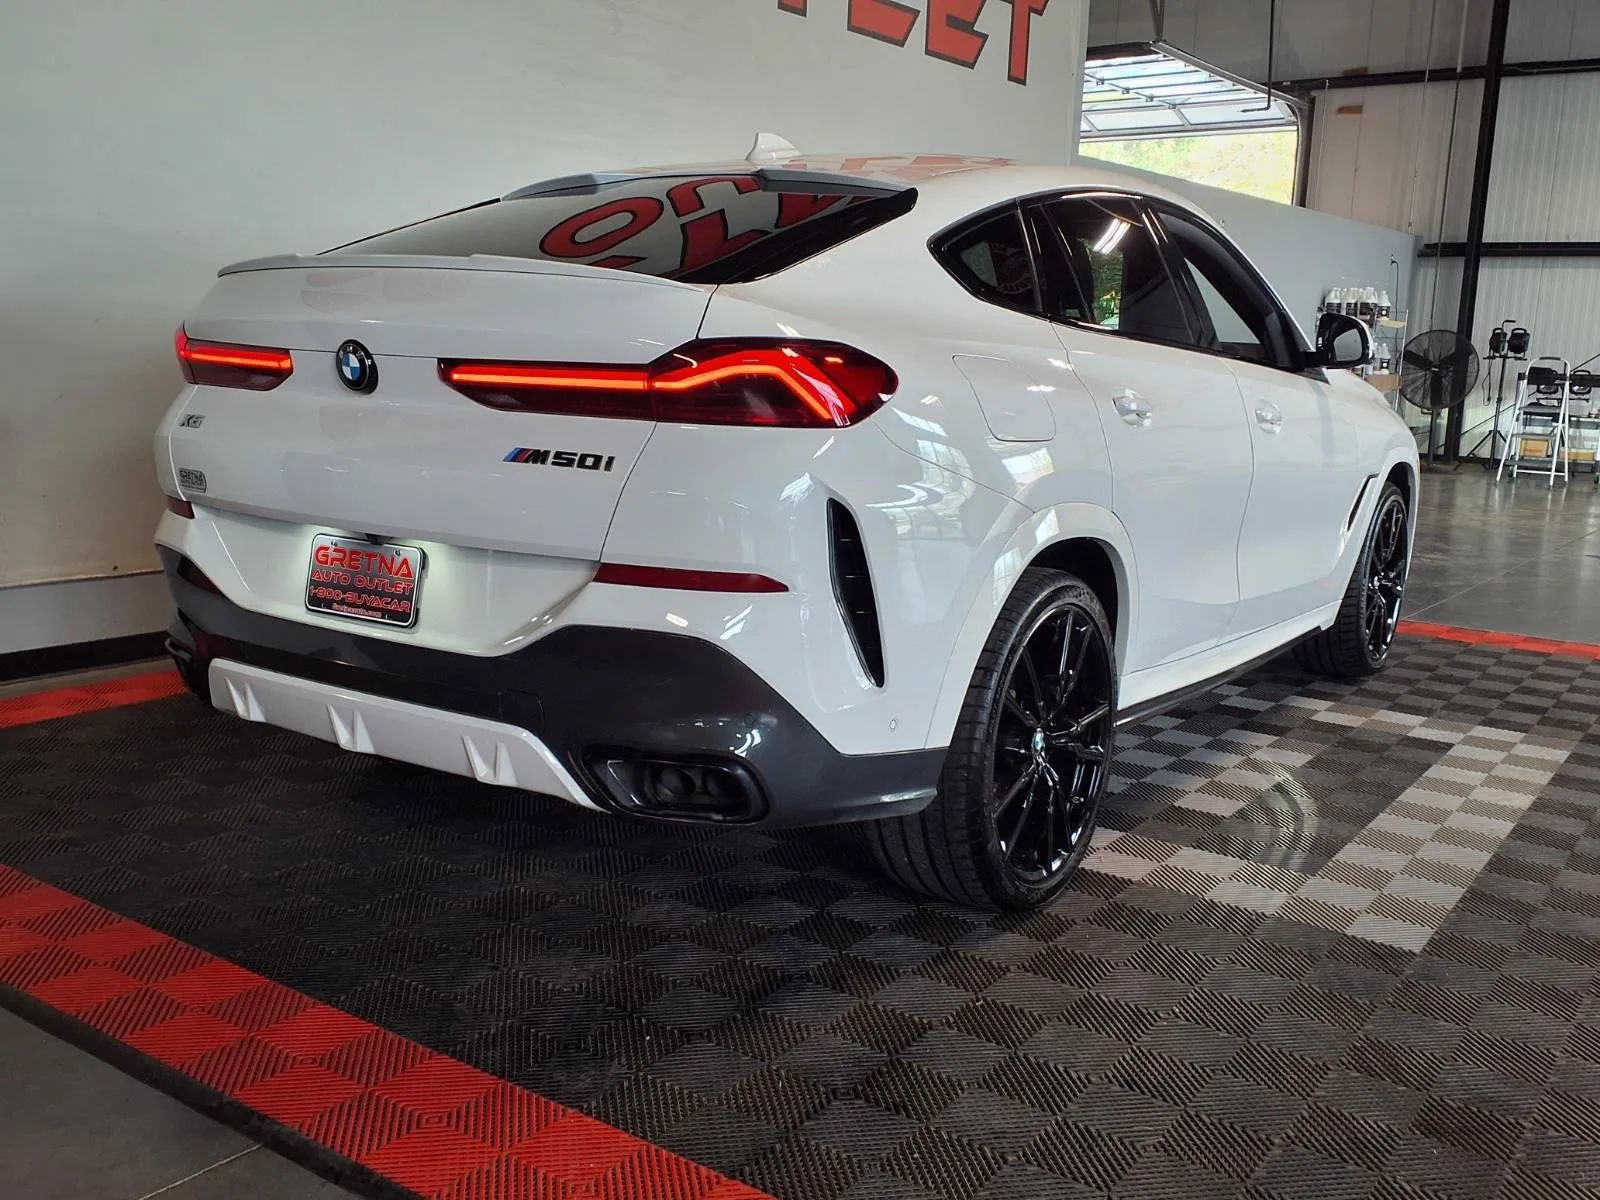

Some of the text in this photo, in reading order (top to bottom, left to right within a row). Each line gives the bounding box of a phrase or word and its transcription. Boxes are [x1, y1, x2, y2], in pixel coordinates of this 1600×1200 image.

[314, 544, 414, 579] GRETNA
[312, 568, 414, 596] AUTO OUTLET
